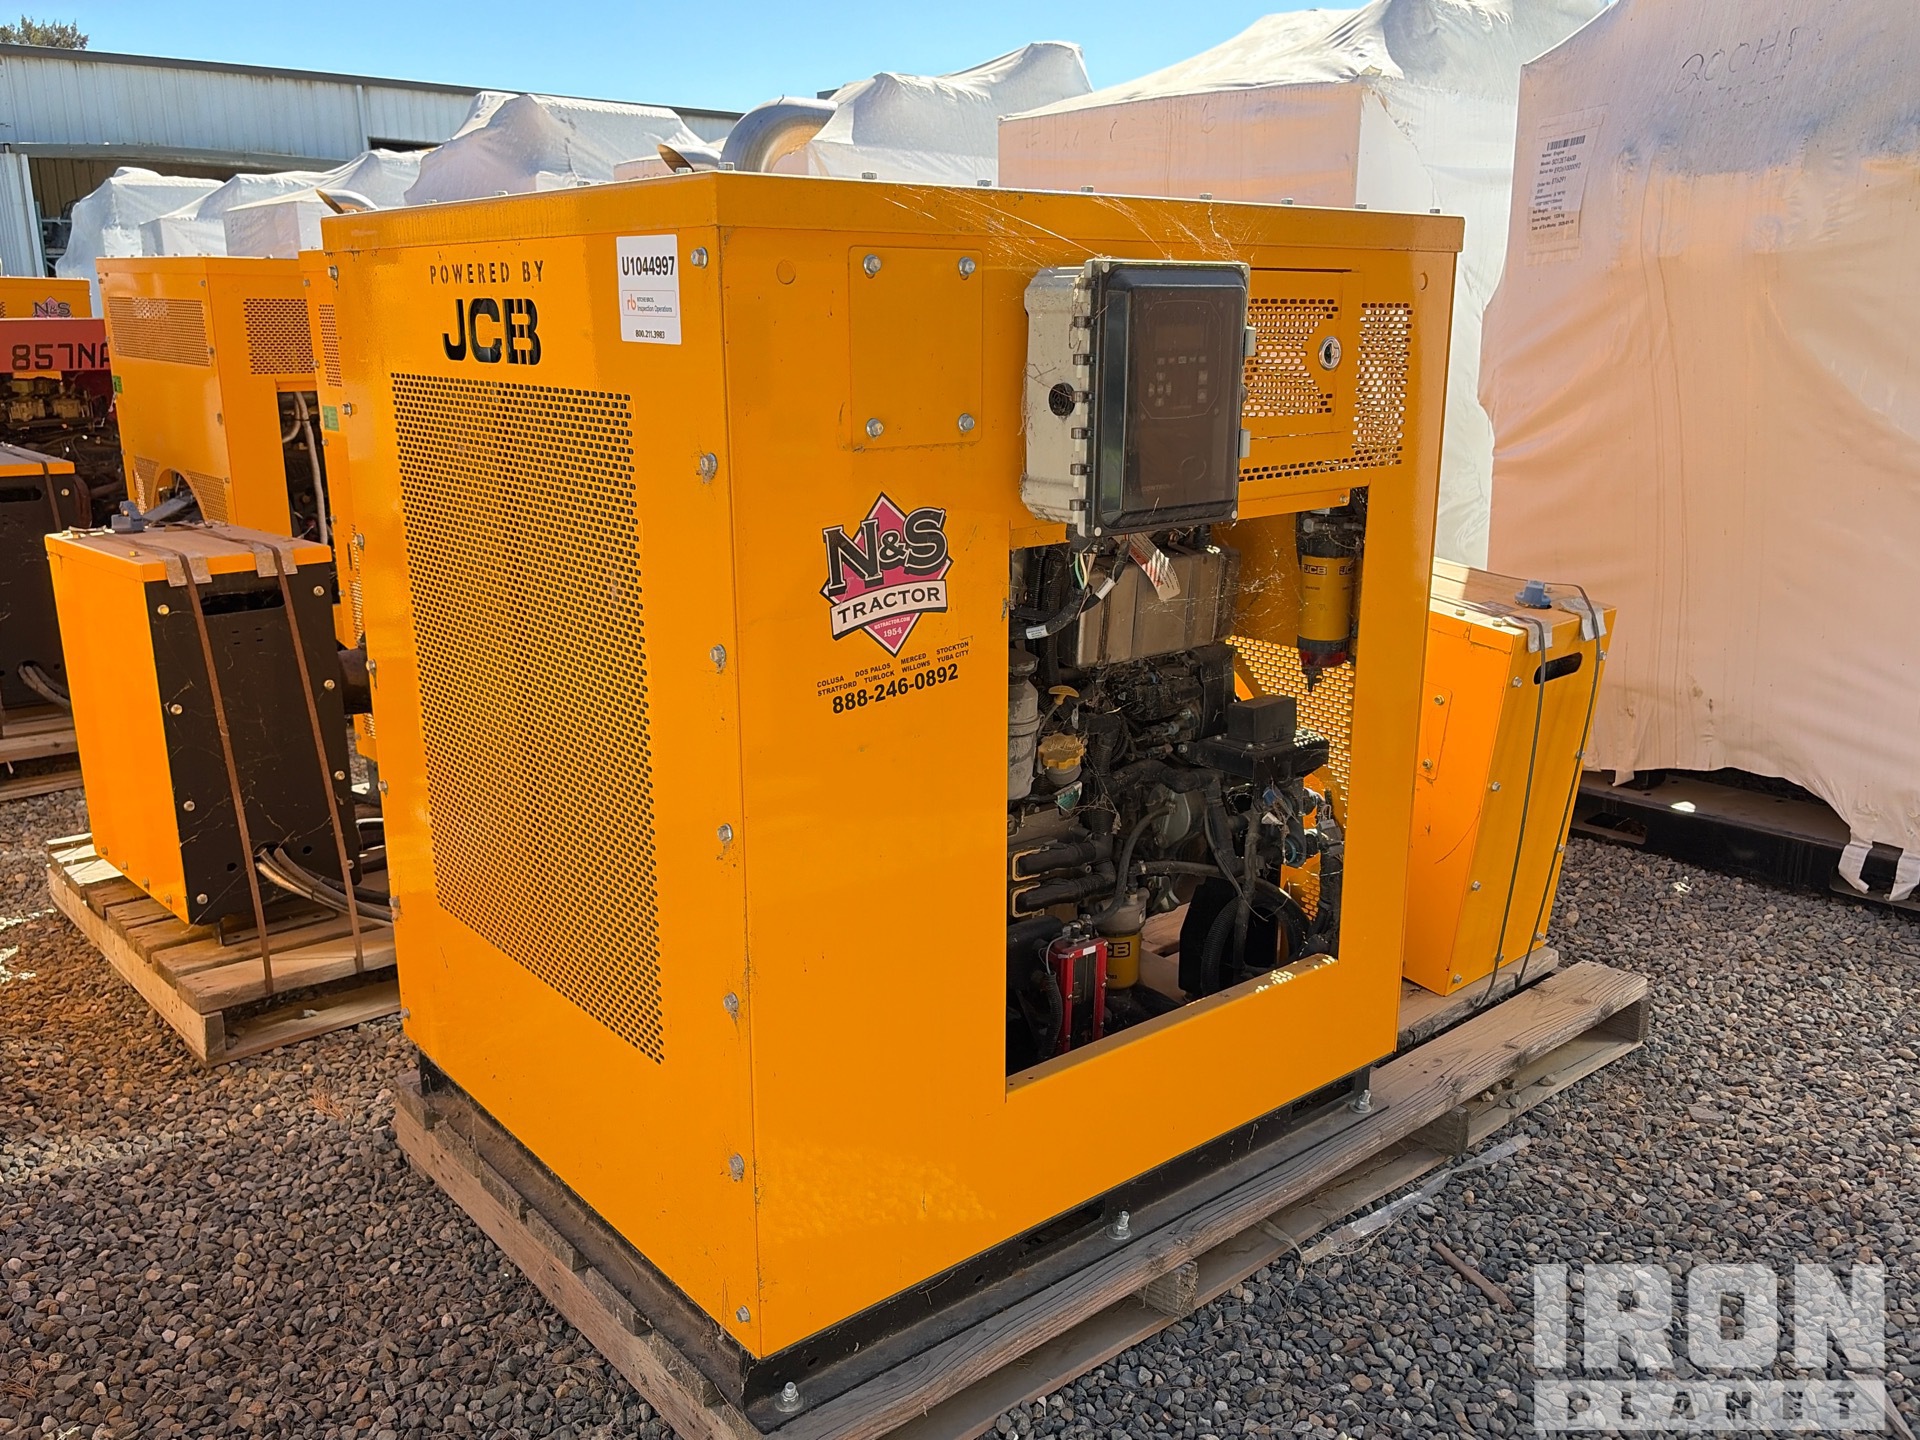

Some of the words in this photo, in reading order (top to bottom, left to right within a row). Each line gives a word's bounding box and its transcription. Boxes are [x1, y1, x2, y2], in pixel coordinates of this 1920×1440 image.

[430, 261, 510, 285] POWERED
[522, 260, 543, 283] BY
[621, 256, 675, 276] U1044997
[442, 297, 542, 366] JCB
[821, 506, 948, 598] N&S
[1304, 565, 1327, 575] JCB
[837, 586, 941, 624] TRACTOR
[883, 626, 902, 638] 1954
[817, 675, 844, 688] COLUSA
[855, 668, 868, 678] DOS
[870, 662, 891, 675] PALOS
[901, 653, 927, 665] MERCED
[936, 641, 969, 655] STOCKTON
[817, 680, 857, 696] STRATFORD
[864, 670, 895, 684] TURLOCK
[901, 660, 931, 673] WILLOWS
[937, 654, 954, 663] YUBA
[955, 649, 969, 660] CITY
[832, 663, 959, 714] 888-246-0892
